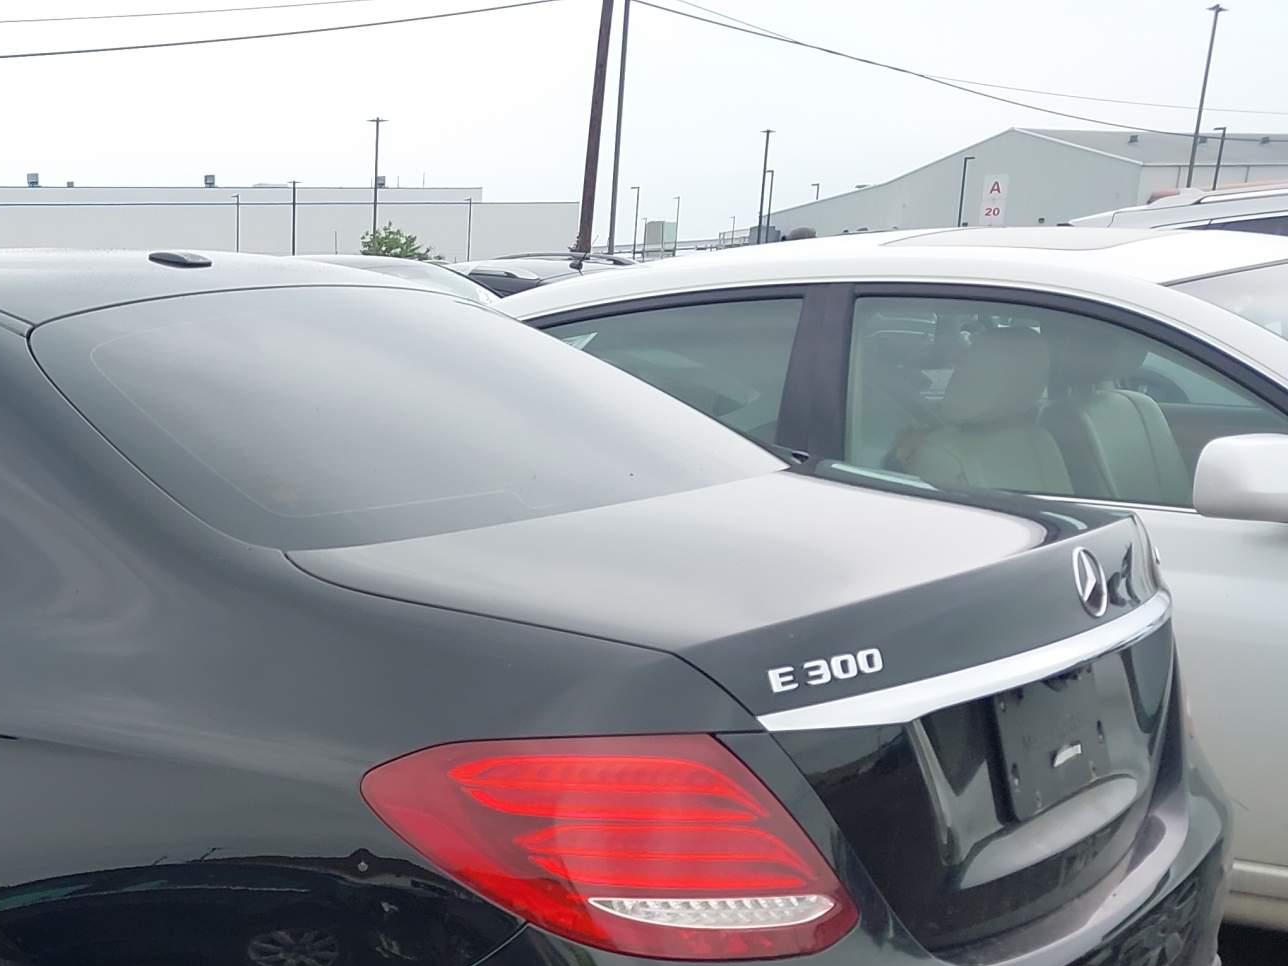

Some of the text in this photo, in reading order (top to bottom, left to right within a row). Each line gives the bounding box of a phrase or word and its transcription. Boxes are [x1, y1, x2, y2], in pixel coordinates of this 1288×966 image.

[989, 180, 1001, 194] A
[984, 207, 1001, 217] 20
[767, 648, 883, 693] E 300
